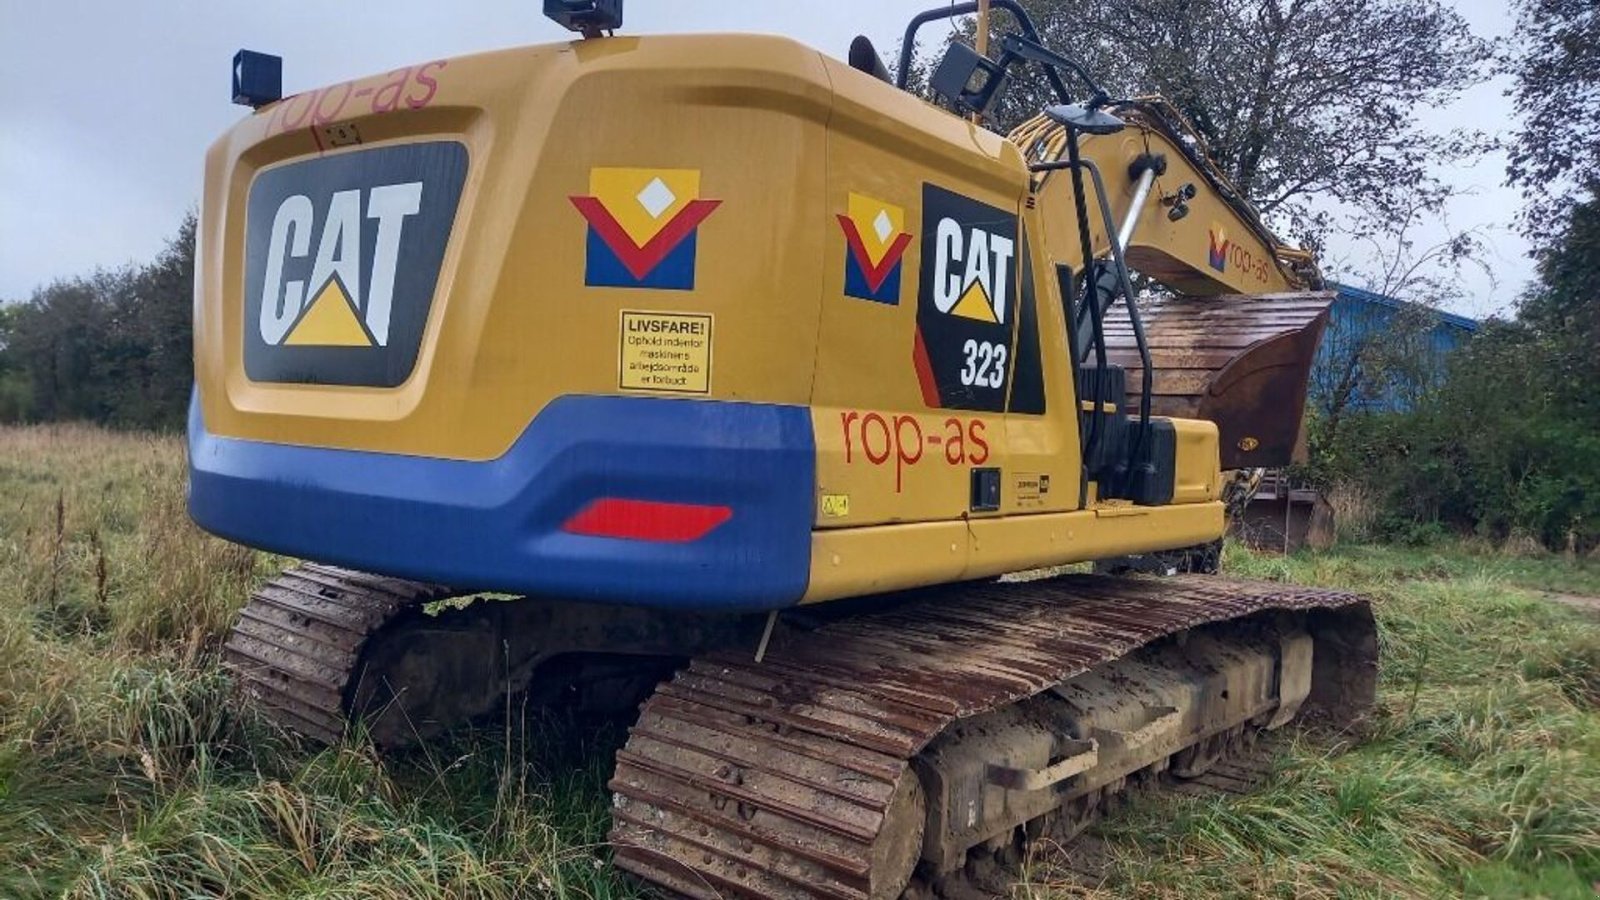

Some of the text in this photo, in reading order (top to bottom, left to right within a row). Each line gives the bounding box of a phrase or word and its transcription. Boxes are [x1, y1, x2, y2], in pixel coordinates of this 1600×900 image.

[259, 181, 423, 347] CAT
[934, 216, 1014, 324] CAT
[628, 319, 705, 335] LIVSFARE!
[961, 339, 1007, 389] 323
[840, 411, 989, 493] rop-as
